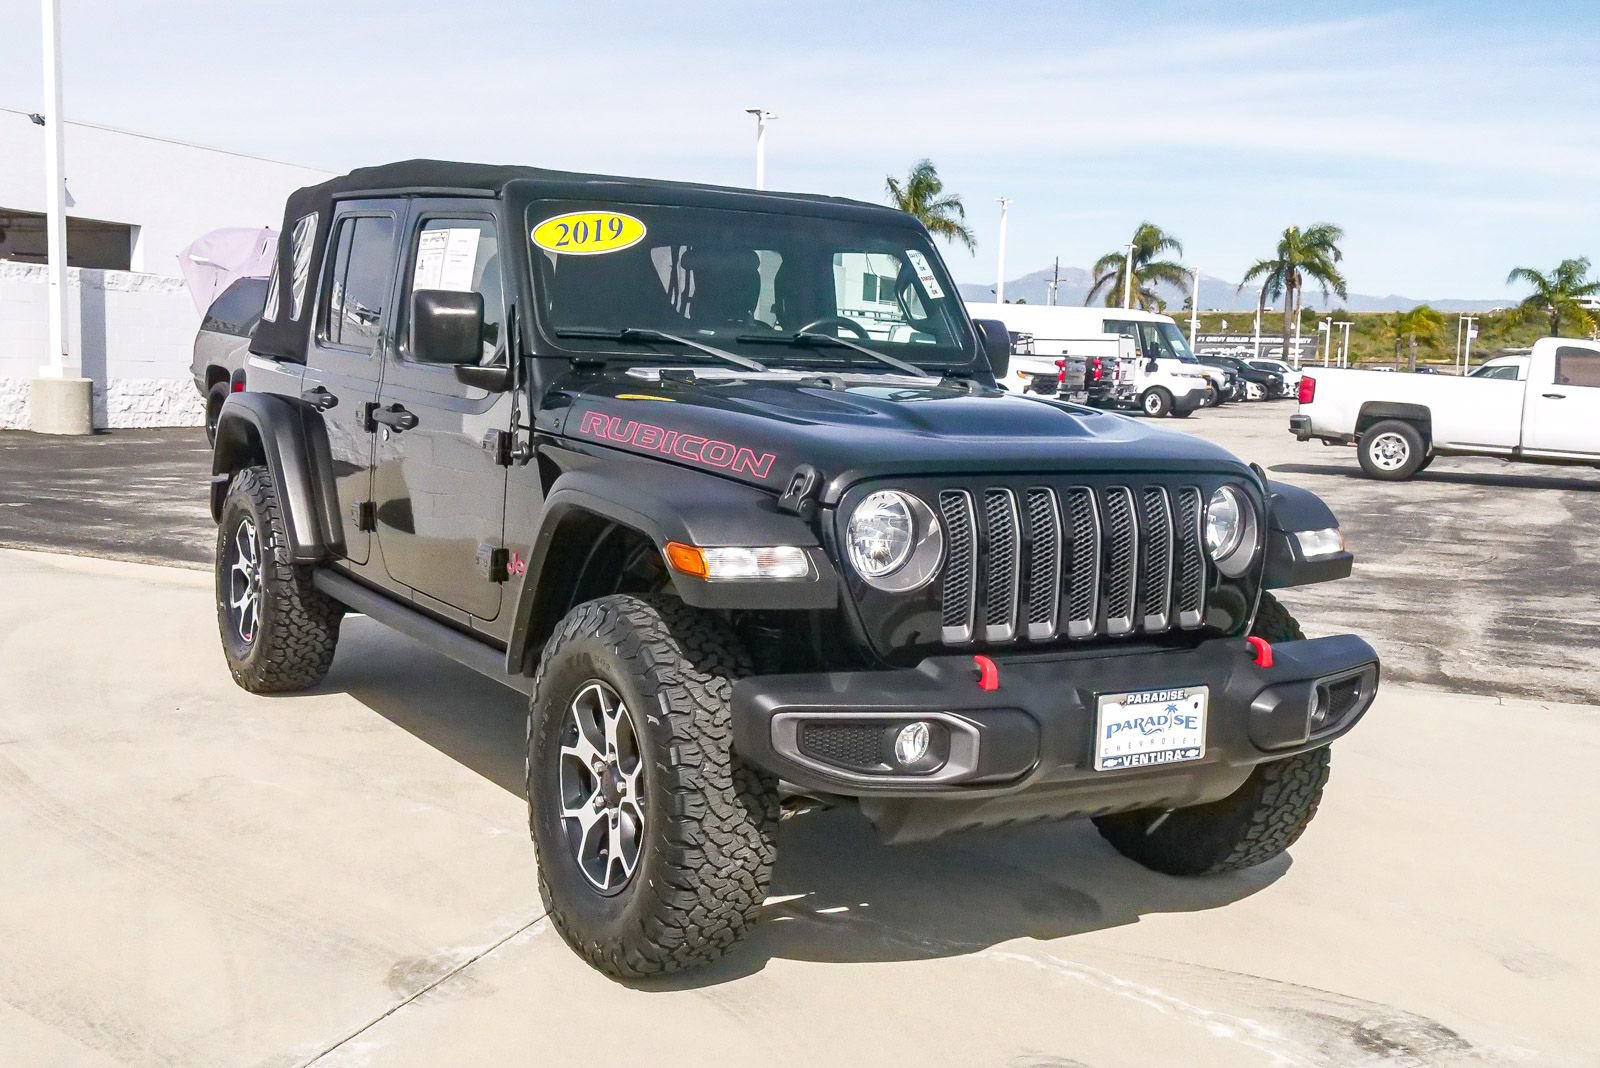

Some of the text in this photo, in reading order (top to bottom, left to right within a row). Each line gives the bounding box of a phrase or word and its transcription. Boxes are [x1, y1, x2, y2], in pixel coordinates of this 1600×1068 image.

[554, 217, 624, 247] 2019
[579, 410, 777, 479] RUBICON
[1127, 690, 1184, 705] PARADISE
[1105, 706, 1198, 740] PARADISE
[1104, 737, 1197, 755] CHEVROLET
[1122, 750, 1182, 767] VENTURA
